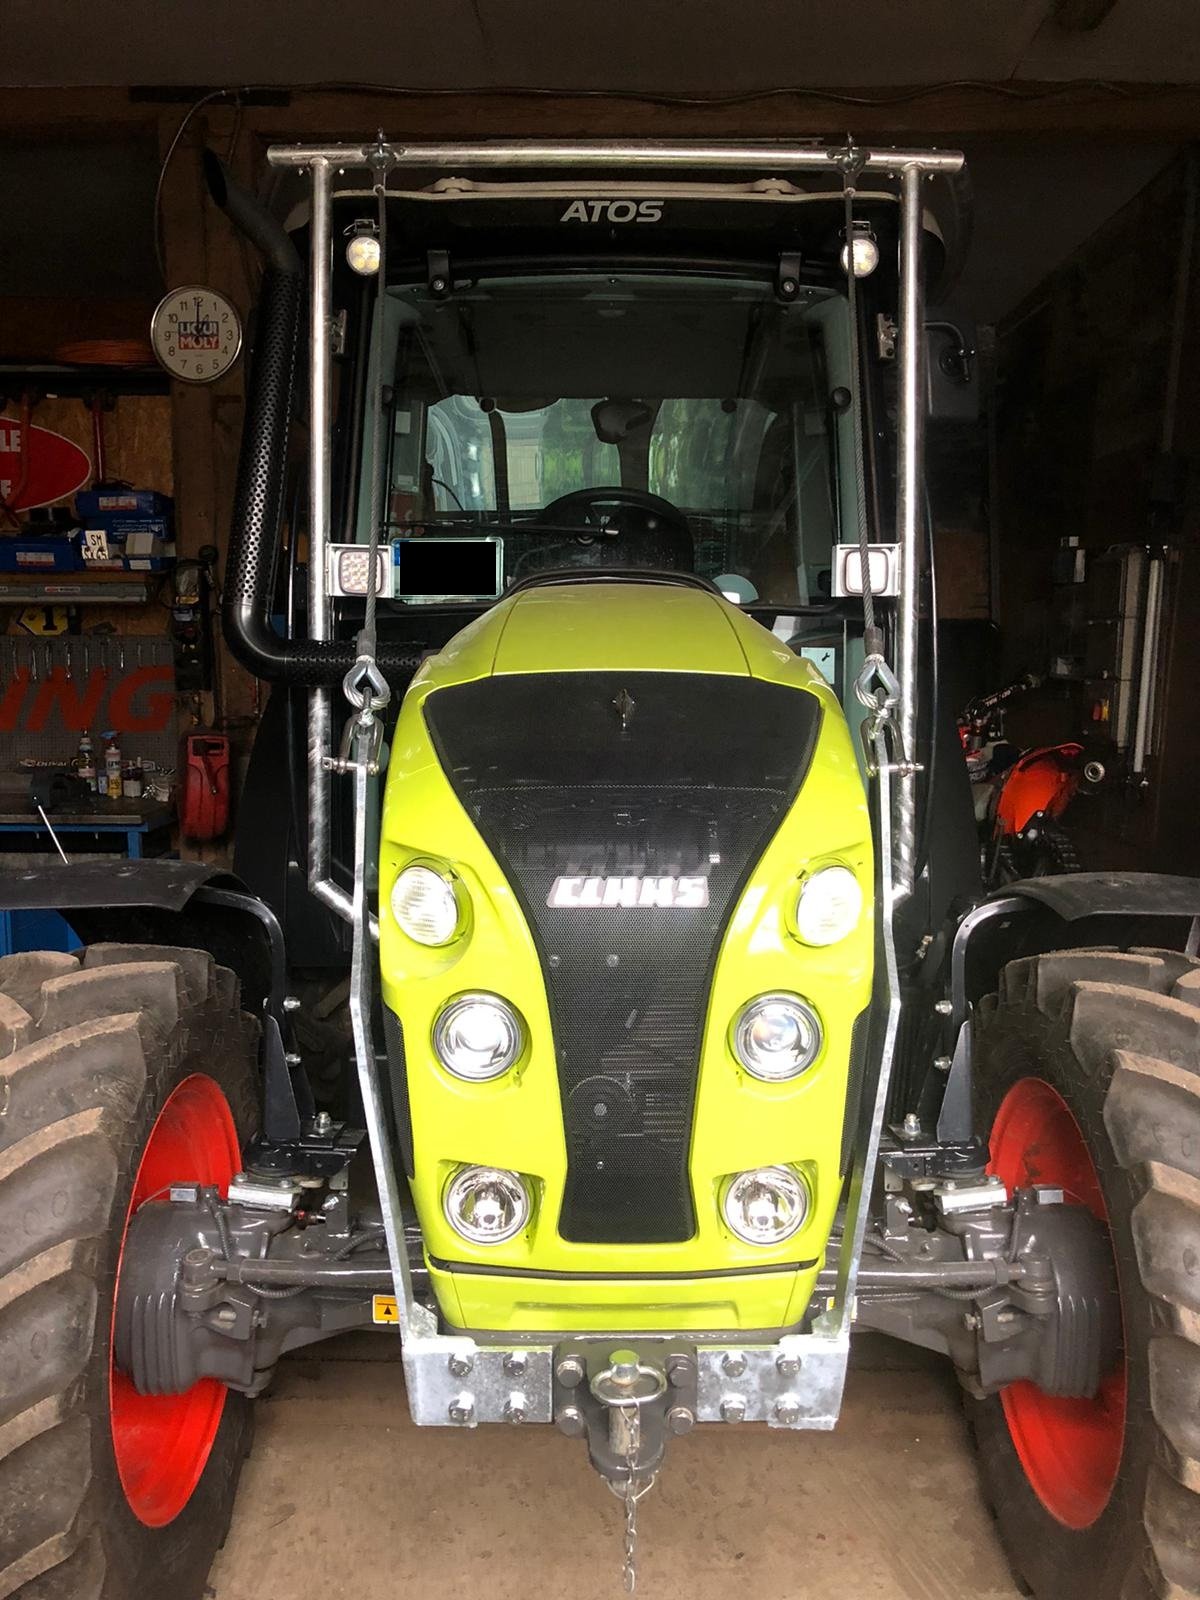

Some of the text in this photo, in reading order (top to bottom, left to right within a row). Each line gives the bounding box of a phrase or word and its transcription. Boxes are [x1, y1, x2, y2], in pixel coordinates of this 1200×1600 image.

[560, 200, 664, 223] ATOS
[179, 301, 188, 311] 11
[193, 296, 203, 307] 12
[168, 313, 178, 324] 10
[221, 313, 229, 323] 2
[164, 331, 171, 341] 9
[226, 330, 233, 341] 3
[180, 336, 219, 349] MOLY
[168, 346, 175, 356] 8
[222, 345, 228, 355] 4
[181, 359, 187, 369] 7
[196, 363, 203, 374] 6
[212, 359, 219, 370] 5
[552, 877, 708, 907] CLAAS
